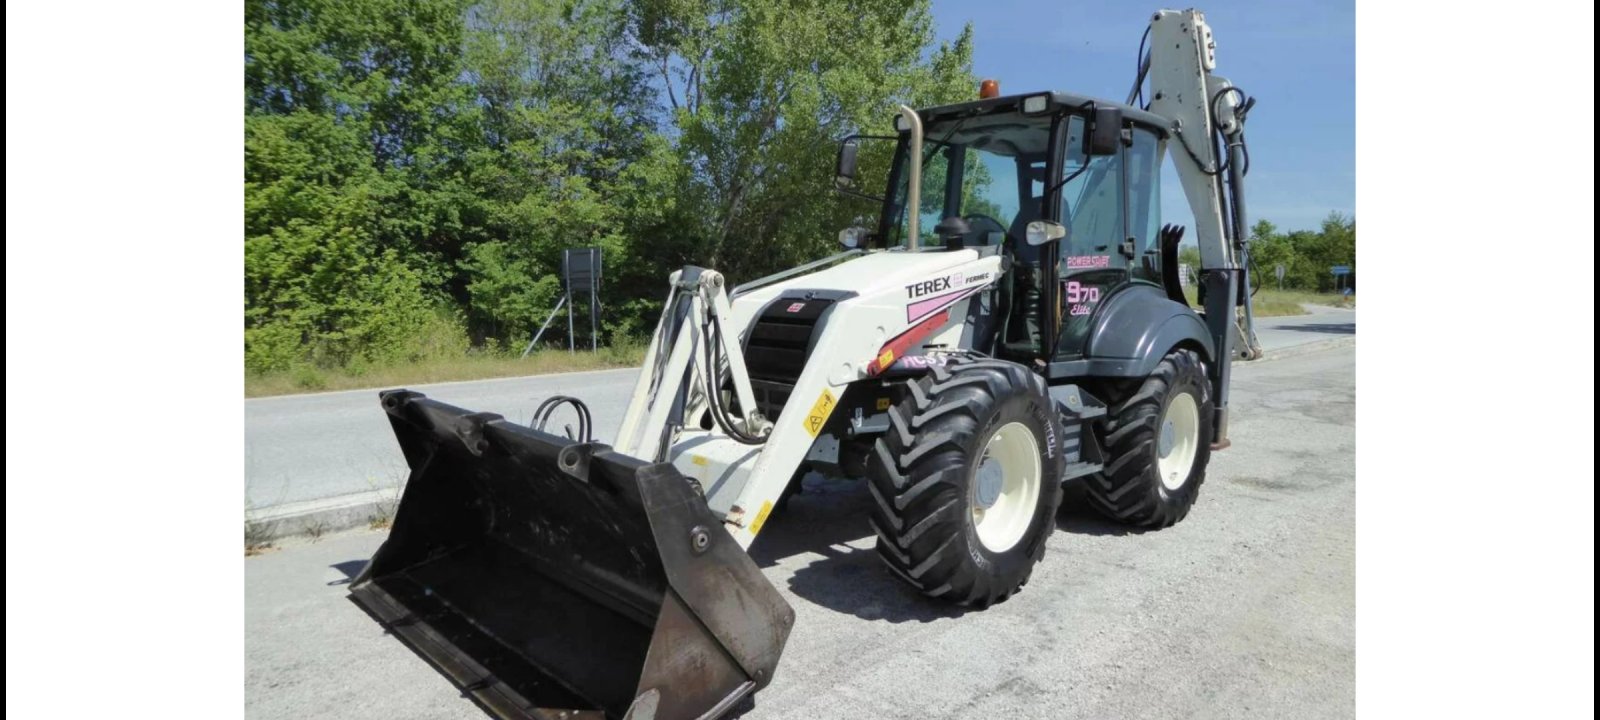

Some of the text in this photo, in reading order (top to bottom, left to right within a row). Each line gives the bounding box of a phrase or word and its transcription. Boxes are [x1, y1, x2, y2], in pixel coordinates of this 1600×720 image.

[905, 273, 990, 298] TEREX FERMEC
[1067, 281, 1098, 302] 970
[1070, 304, 1091, 315] Elite
